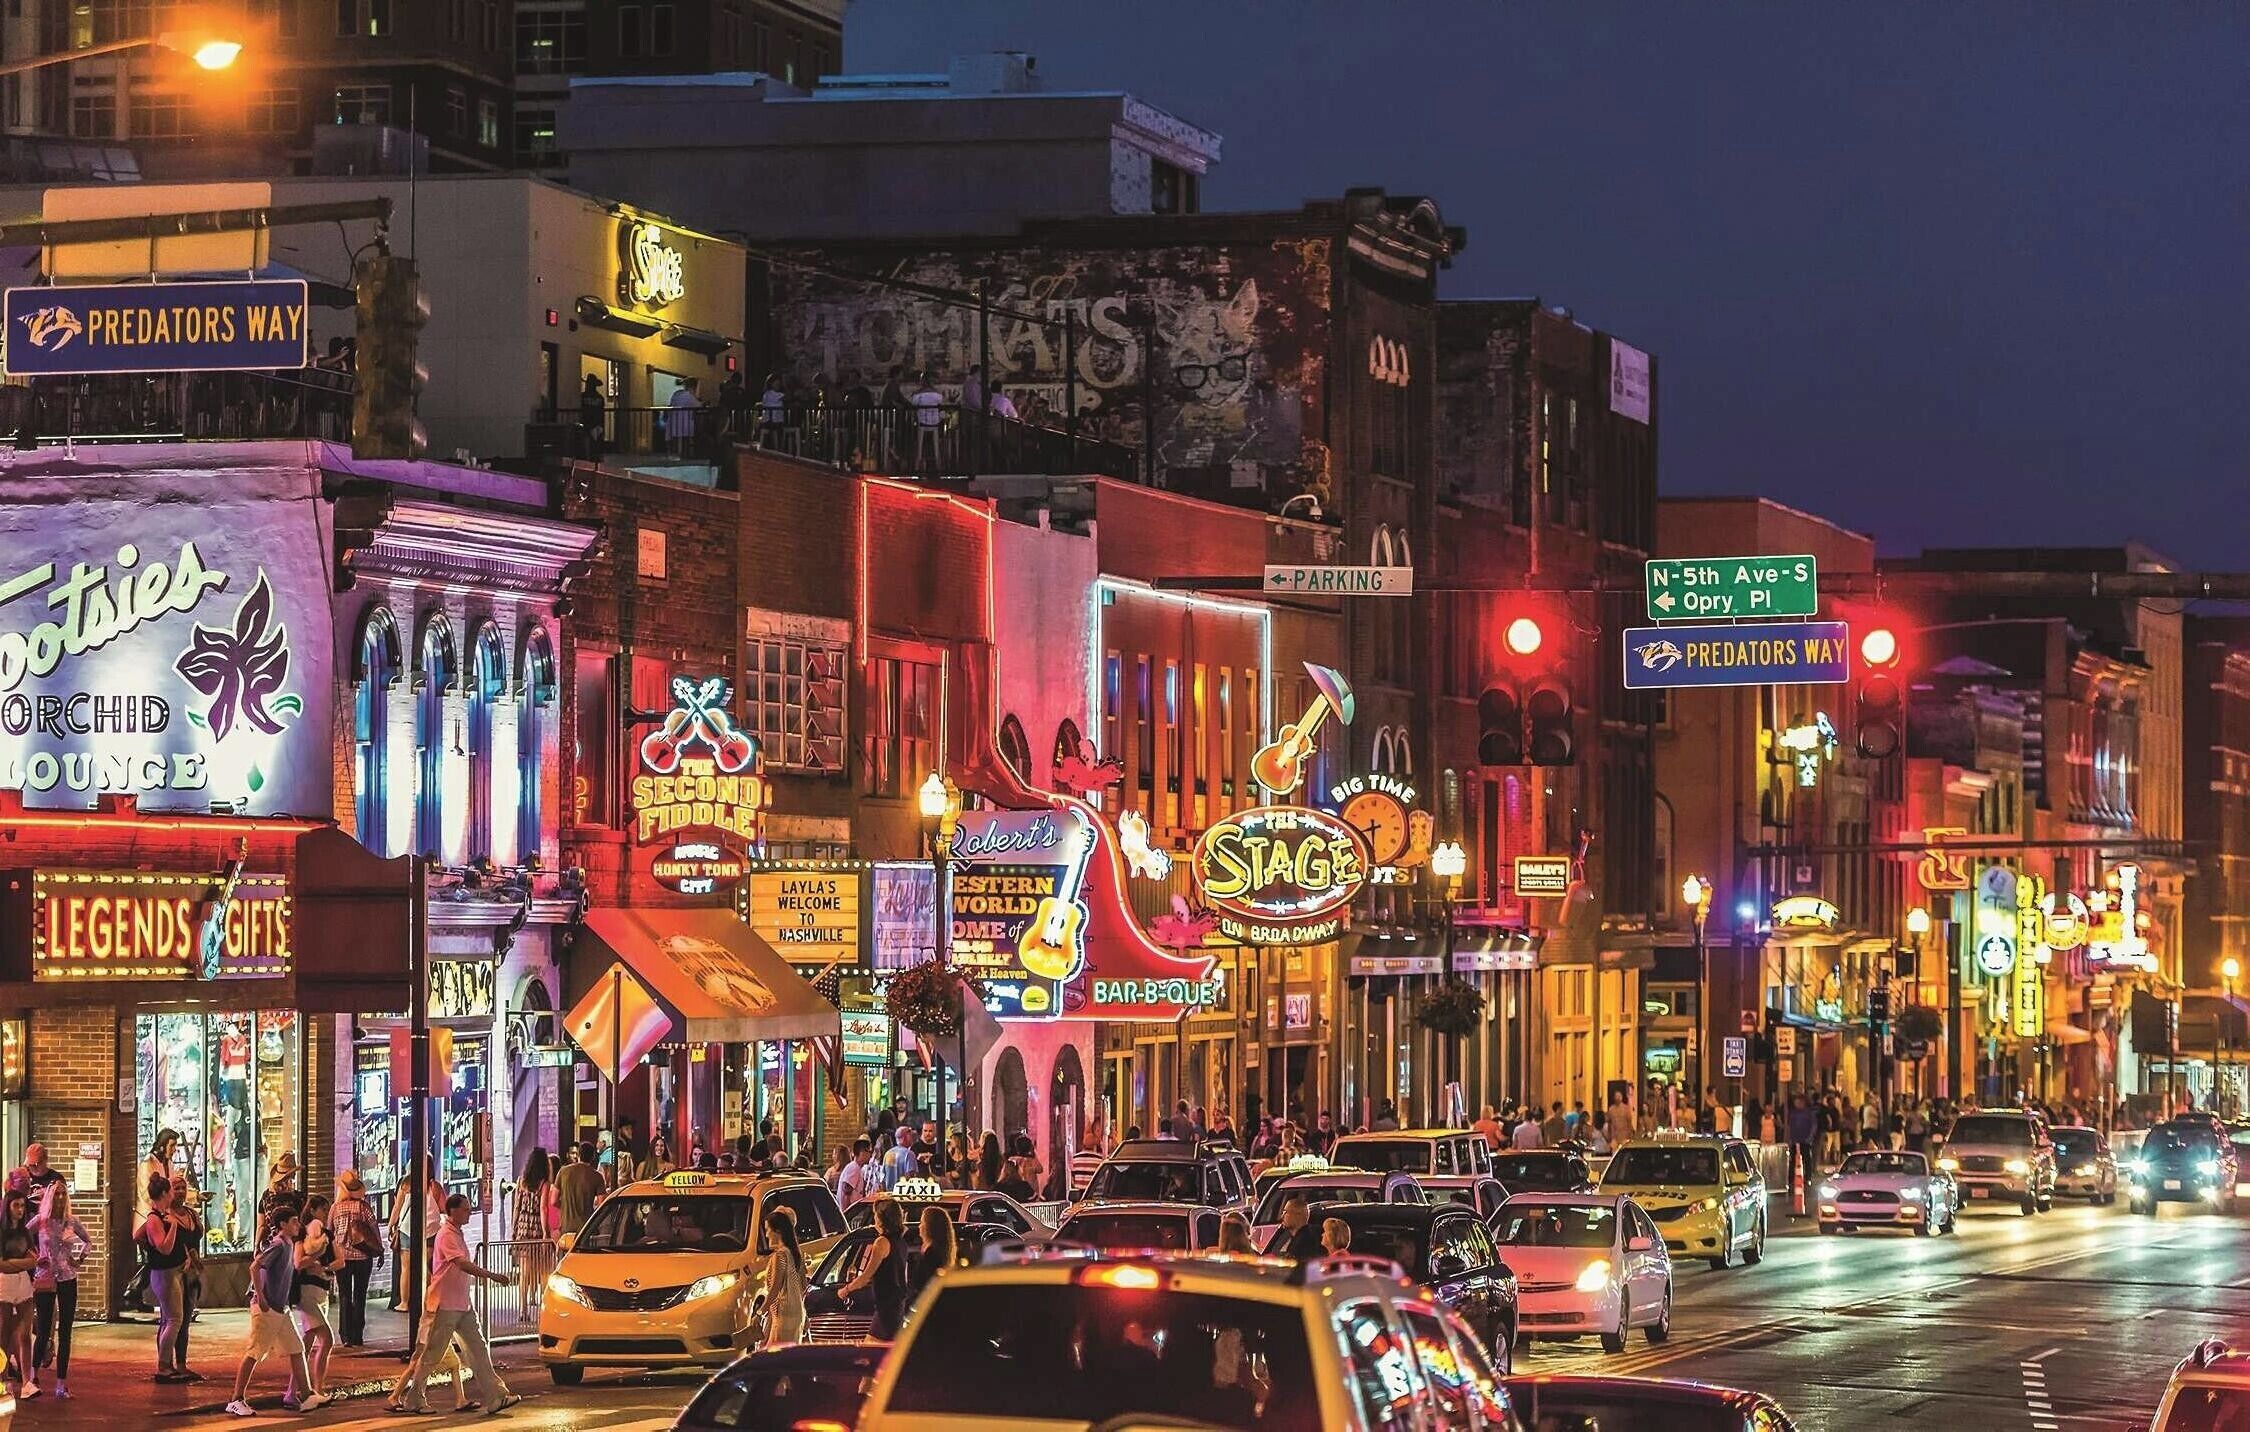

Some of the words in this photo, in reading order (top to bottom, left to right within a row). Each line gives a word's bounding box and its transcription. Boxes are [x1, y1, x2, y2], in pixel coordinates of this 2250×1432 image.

[630, 225, 685, 304] STAGE
[88, 306, 235, 345] PREDATORS
[247, 305, 302, 342] WAY
[1294, 570, 1382, 590] PARKING
[1683, 591, 1733, 614] Opry
[1750, 590, 1771, 609] Pl
[1686, 639, 1797, 668] PREDATORS
[1804, 638, 1845, 664] WAY
[1, 694, 171, 740] ORCHID
[680, 759, 714, 775] THE
[633, 776, 761, 809] SECOND
[1331, 777, 1364, 803] BIG
[1369, 775, 1416, 803] TIME
[640, 802, 755, 840] FIDDLE
[1264, 812, 1297, 829] THE
[653, 863, 699, 876] HONKY
[702, 863, 740, 876] TONK
[1205, 824, 1361, 898] STAGE
[680, 879, 713, 893] CITY
[781, 880, 836, 894] LAYLA'S
[953, 875, 1055, 895] ESTERN
[778, 897, 840, 910] WELCOME
[51, 898, 191, 958] LEGENDS
[225, 898, 286, 957] GIFTS
[800, 913, 815, 925] TO
[779, 928, 843, 942] NASHVILLE
[953, 921, 1005, 939] OME
[1009, 921, 1024, 943] of
[1222, 920, 1243, 938] ON
[1251, 920, 1337, 942] BROADWAY
[989, 967, 1028, 979] Heaven
[1094, 981, 1214, 1005] BAR-B-QUE
[671, 1175, 706, 1184] YELLOW
[895, 1185, 935, 1194] TAXI
